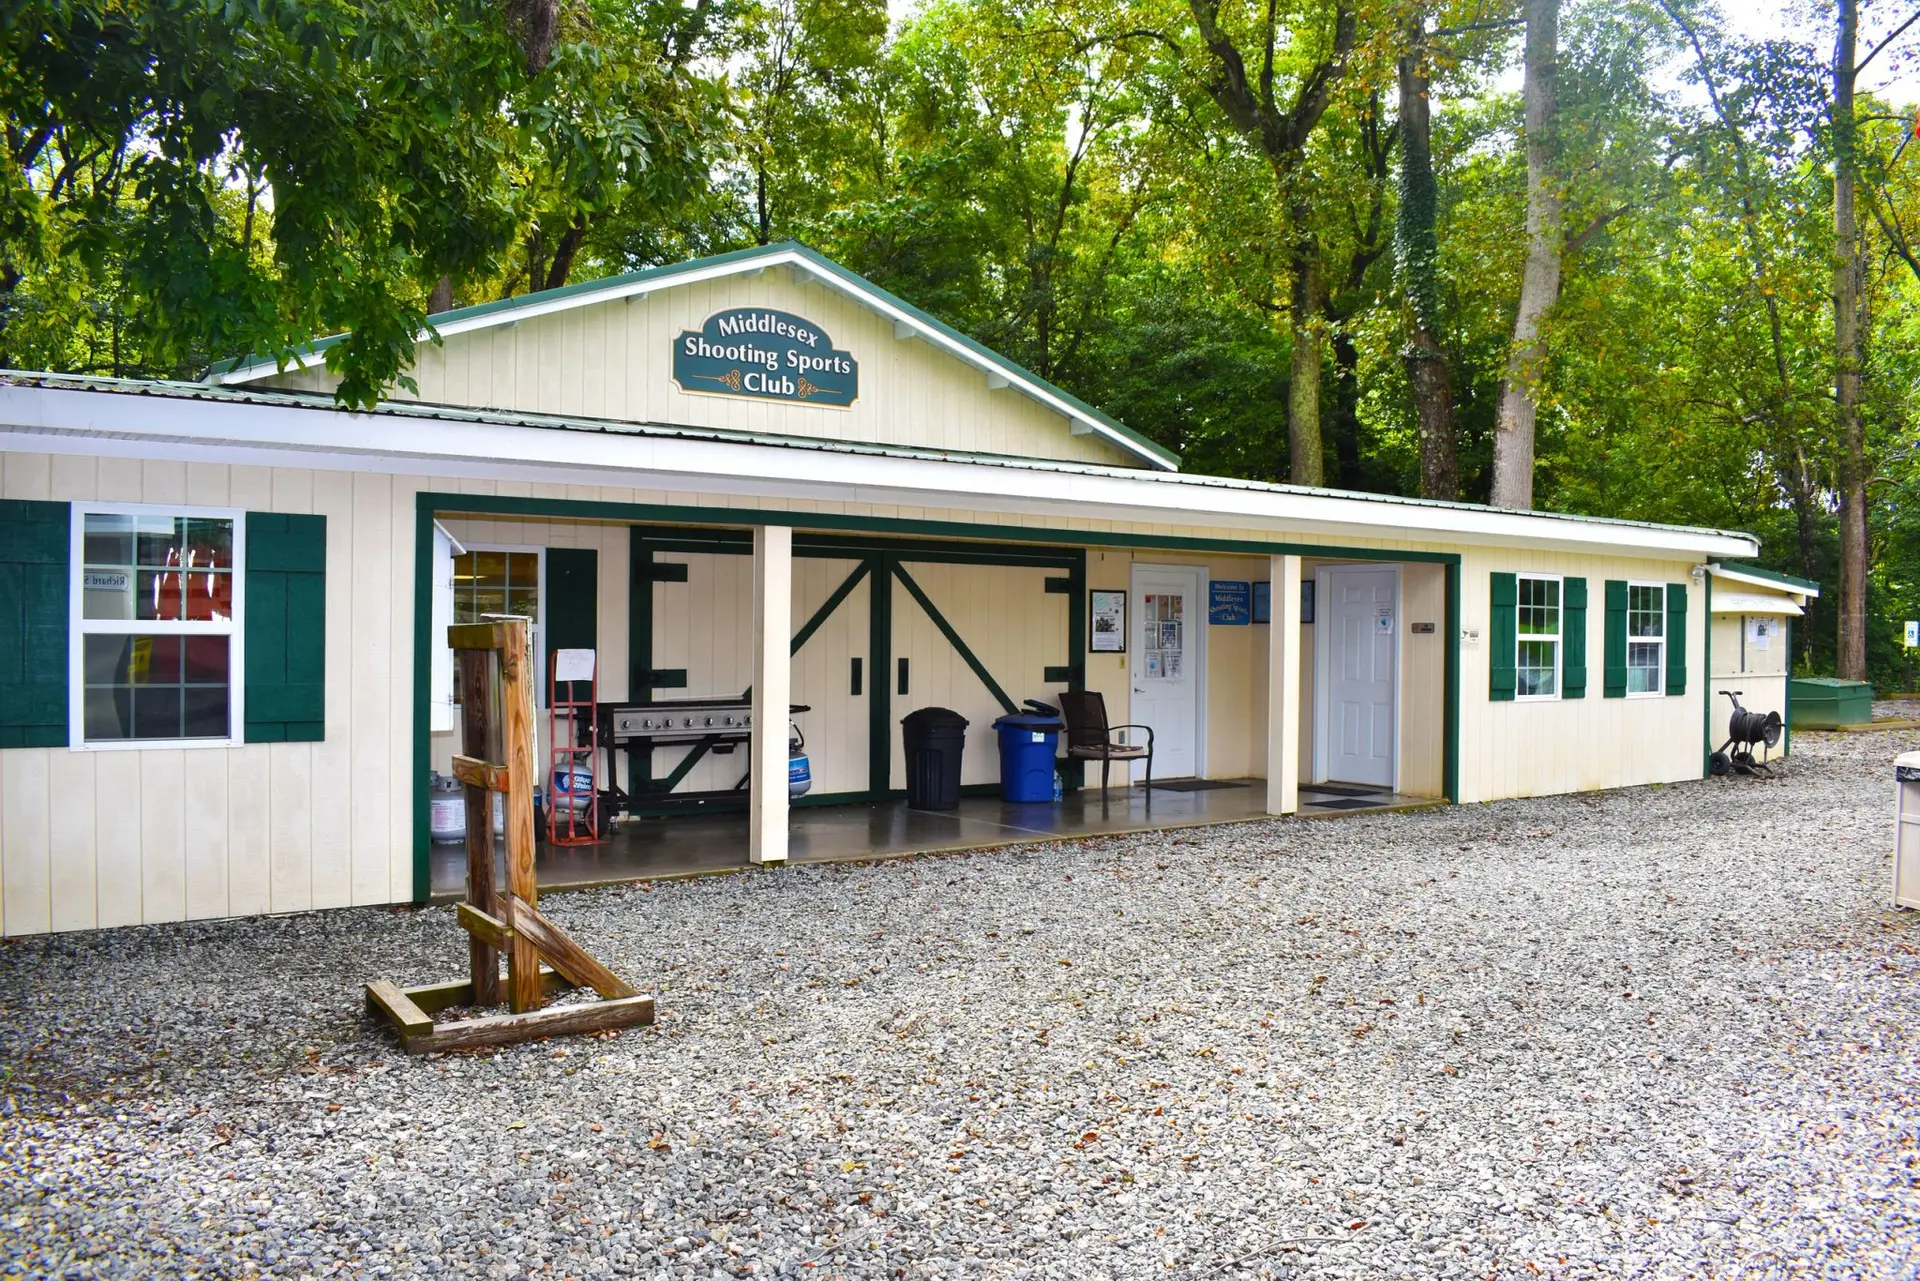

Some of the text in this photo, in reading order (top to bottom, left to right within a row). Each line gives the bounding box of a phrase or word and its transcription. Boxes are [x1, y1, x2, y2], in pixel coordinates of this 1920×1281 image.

[717, 313, 819, 348] Middlesex
[685, 336, 851, 374] Shooting Sports
[743, 372, 795, 395] Club
